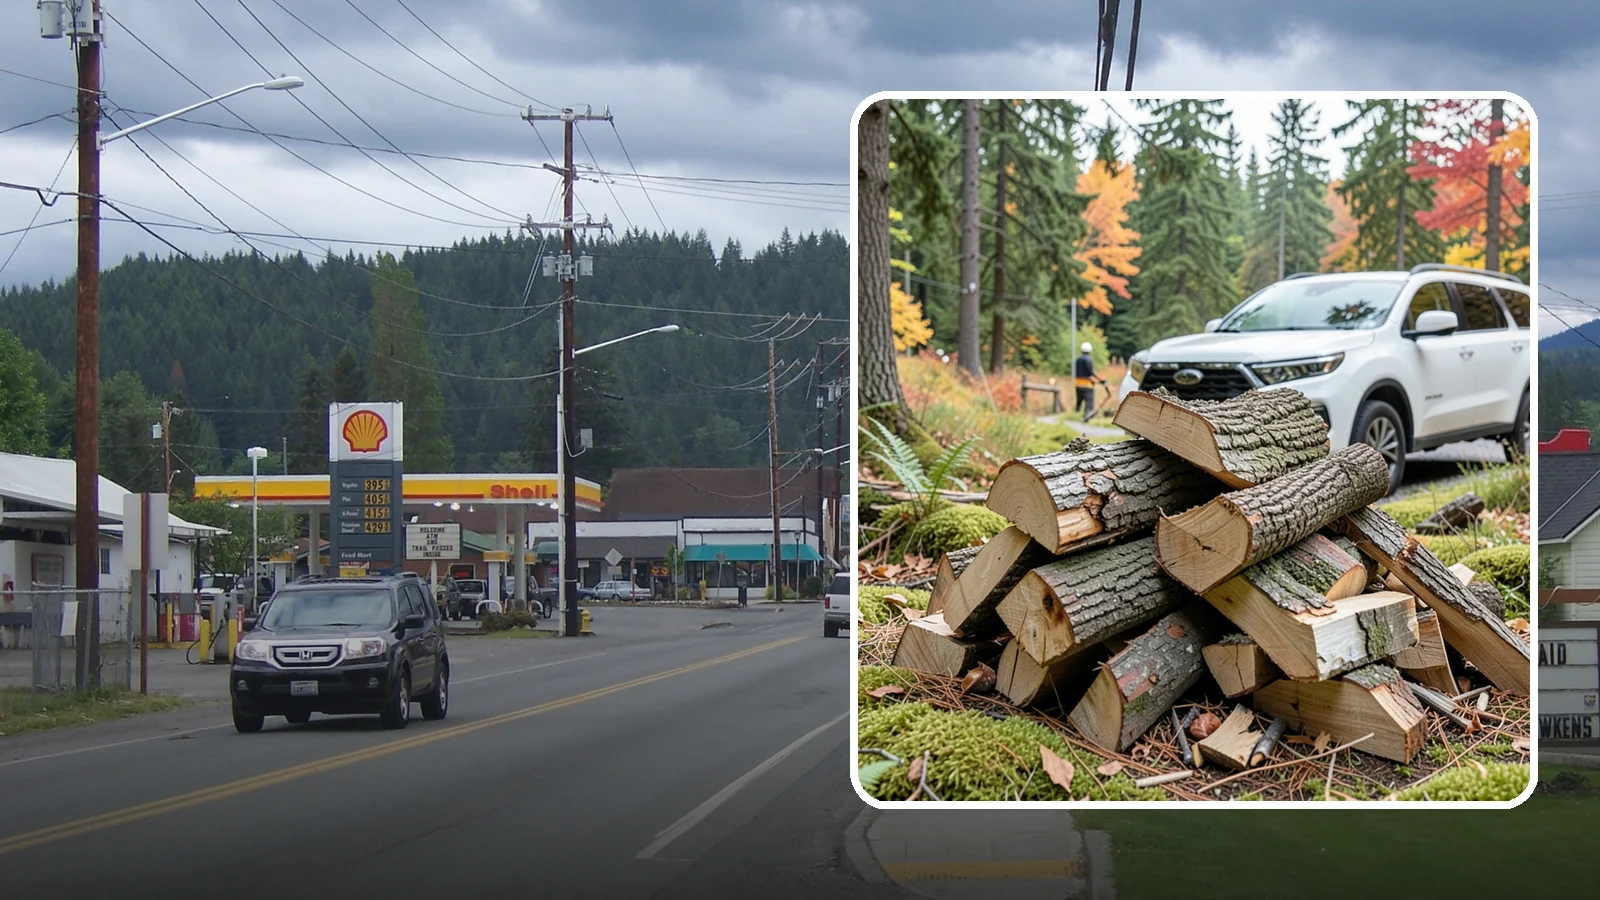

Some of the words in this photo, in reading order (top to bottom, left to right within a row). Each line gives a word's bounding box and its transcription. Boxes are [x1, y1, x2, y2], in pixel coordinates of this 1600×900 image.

[366, 480, 384, 490] 395
[490, 484, 547, 499] Shell
[366, 494, 384, 504] 405
[366, 508, 384, 518] 415
[366, 522, 384, 533] 429
